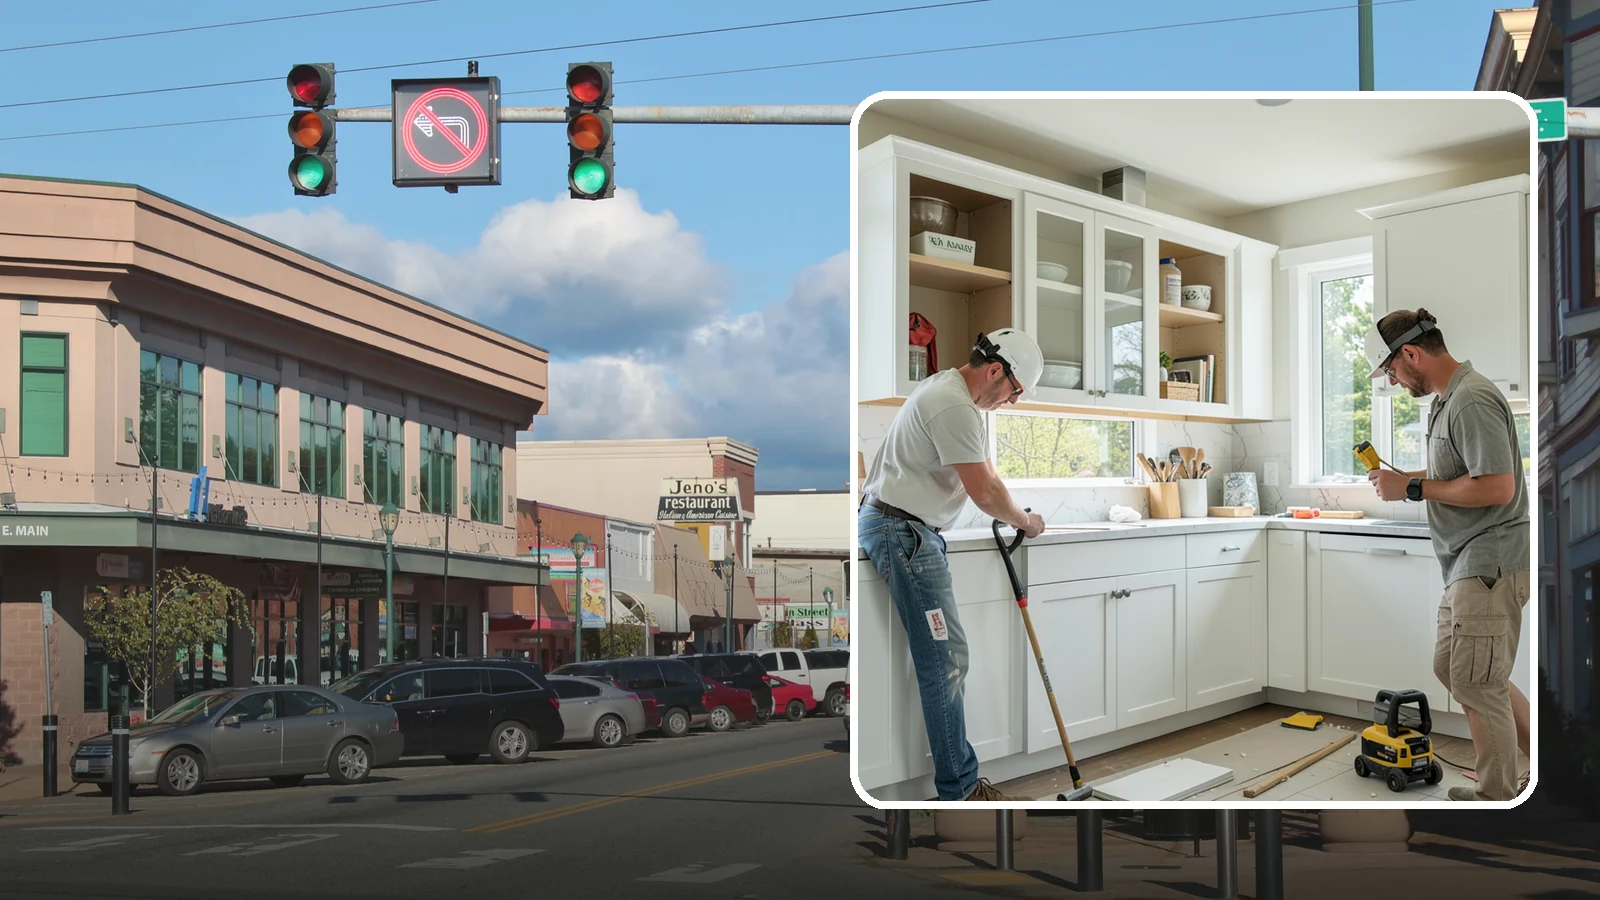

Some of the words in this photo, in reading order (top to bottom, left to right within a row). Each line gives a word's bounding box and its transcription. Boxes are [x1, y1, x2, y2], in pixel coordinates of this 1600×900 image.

[670, 480, 728, 494] Jeno's
[665, 496, 731, 509] restaurant
[658, 510, 682, 520] Italian
[685, 509, 715, 520] American
[715, 509, 738, 520] Cuisine
[2, 525, 13, 536] E.
[15, 525, 49, 536] MAIN
[797, 607, 829, 617] Street
